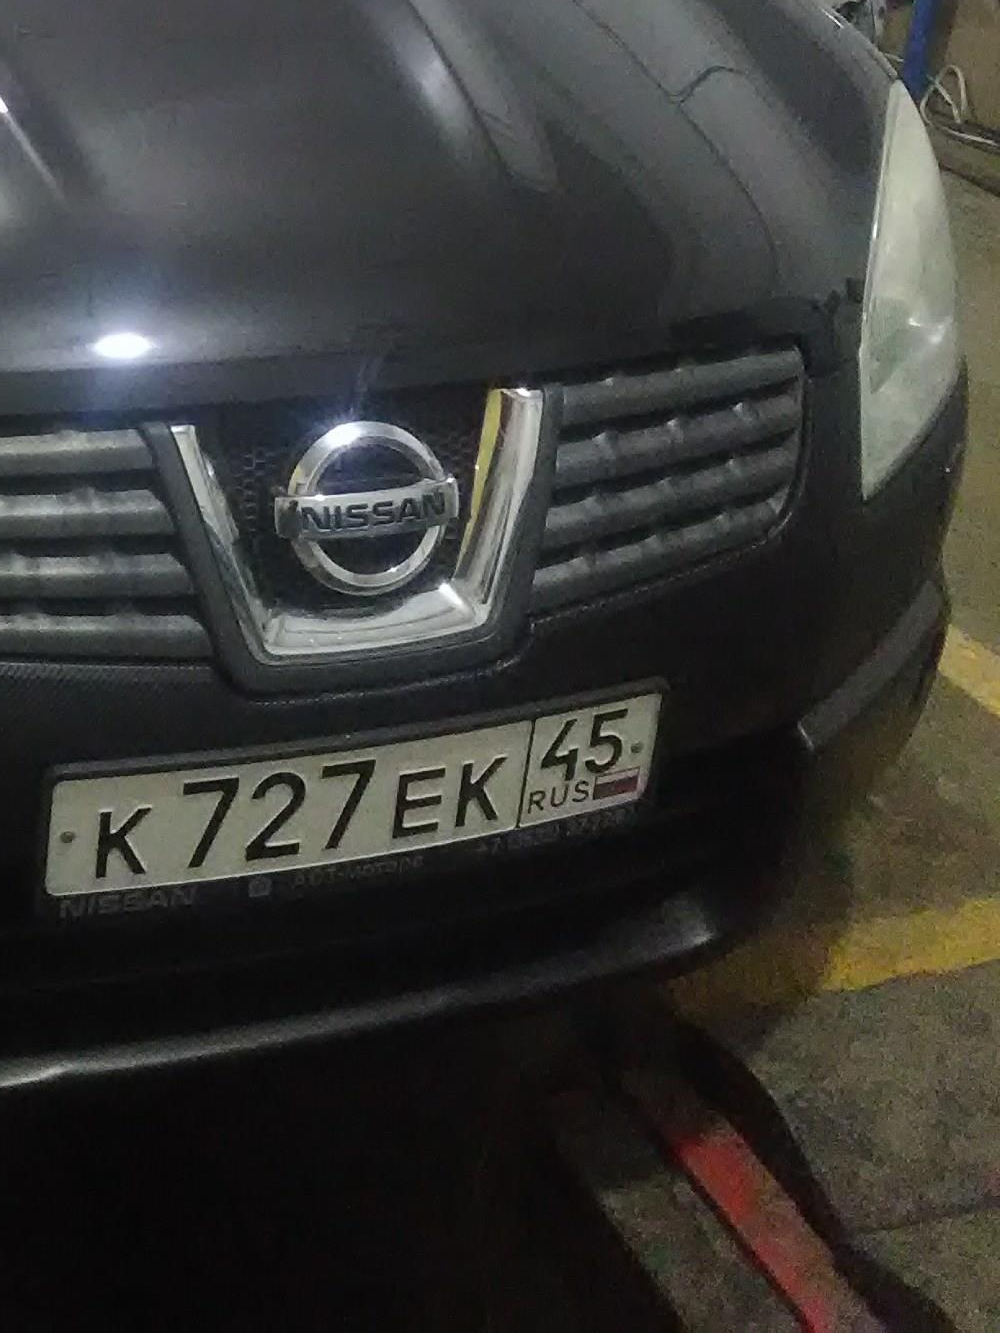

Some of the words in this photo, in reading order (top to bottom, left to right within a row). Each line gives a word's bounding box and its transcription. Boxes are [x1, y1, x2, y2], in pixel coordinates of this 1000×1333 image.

[300, 490, 446, 531] NISSAN
[540, 708, 629, 783] 45
[526, 779, 590, 815] RUS
